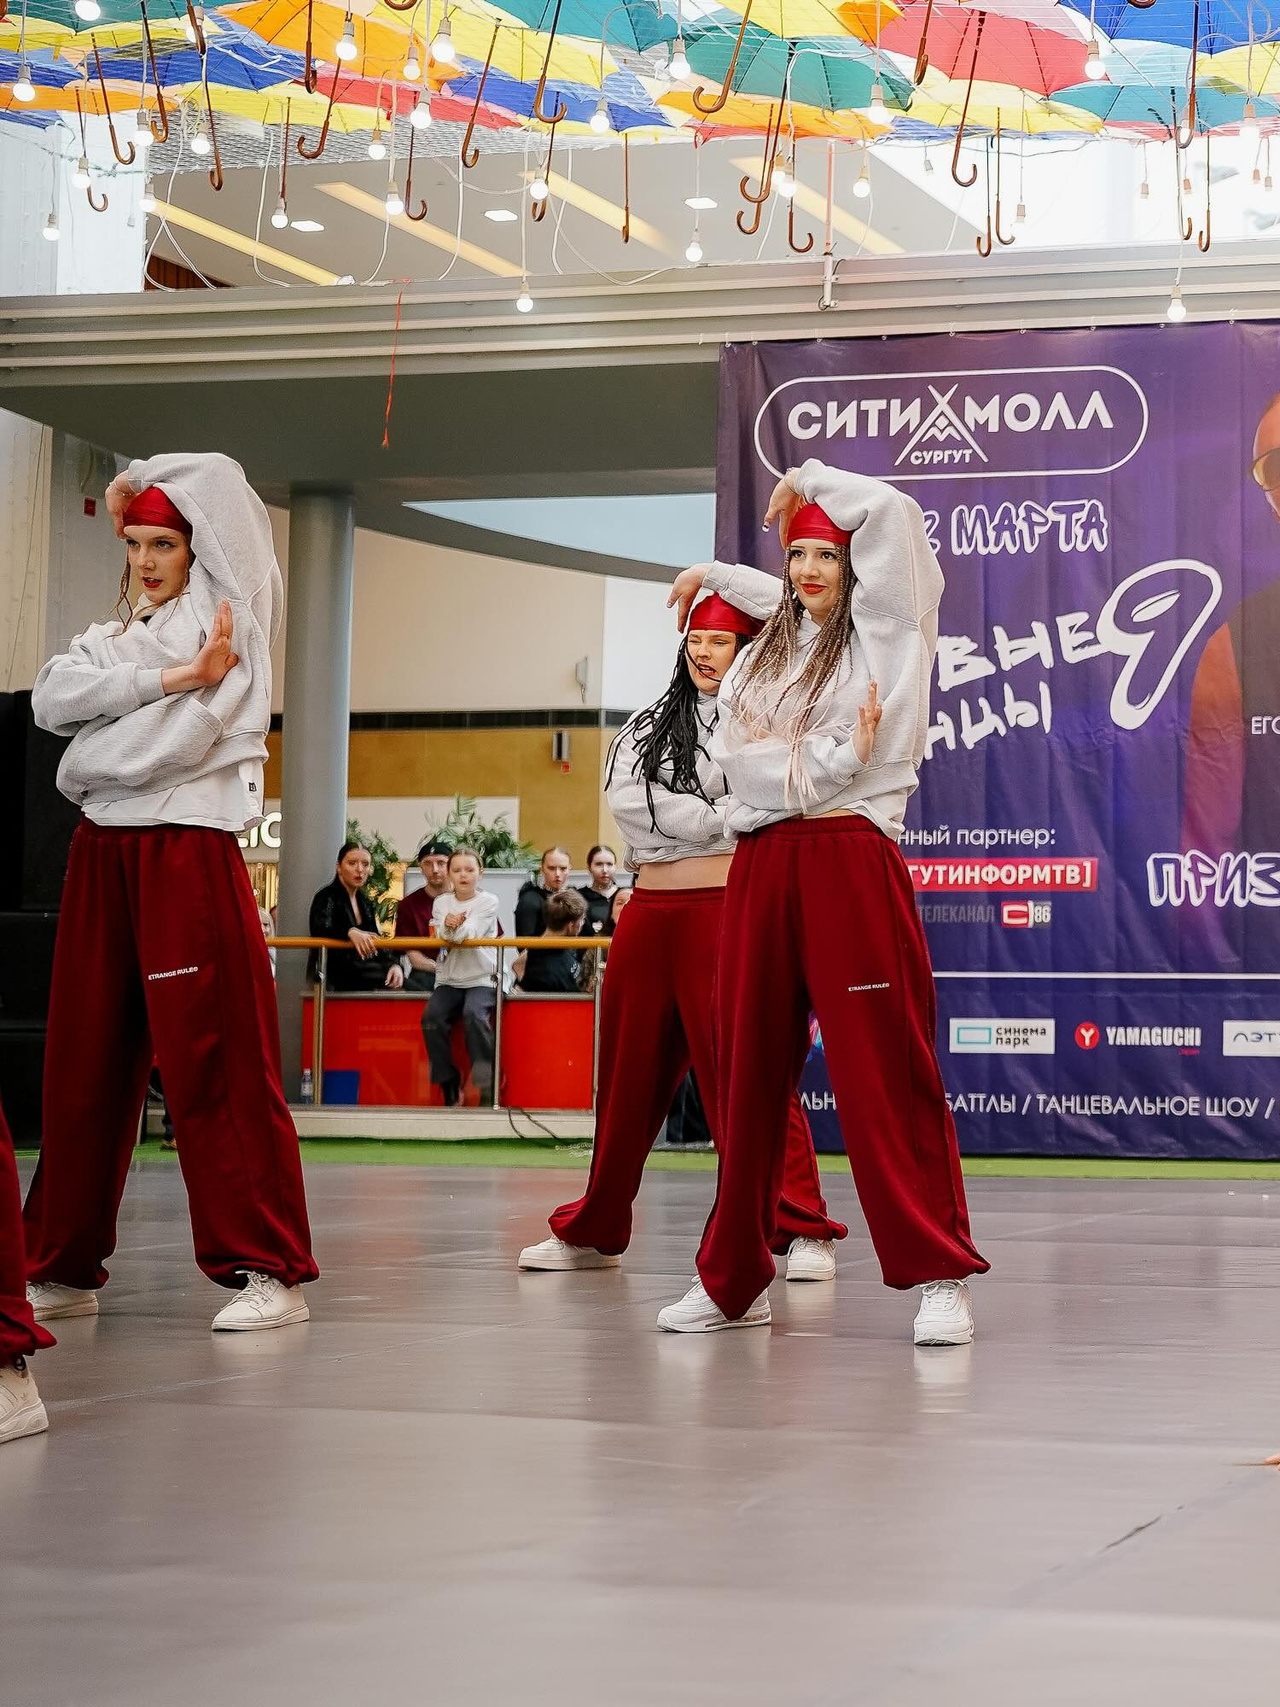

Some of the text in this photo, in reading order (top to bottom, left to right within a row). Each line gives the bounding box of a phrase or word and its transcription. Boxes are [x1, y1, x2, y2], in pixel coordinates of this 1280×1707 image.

[787, 390, 1114, 439] СИТИ МОЛЛ
[910, 449, 973, 465] СУРГУТ
[951, 499, 1109, 556] МАРТА
[956, 828, 1056, 850] партнер:
[996, 1027, 1046, 1036] синема
[1105, 1026, 1202, 1046] YAMAGUCHI
[996, 1037, 1029, 1048] парк
[1036, 1094, 1200, 1116] ТАНЦЕВАЛЬНОЕ
[1205, 1096, 1258, 1118] ШОУ
